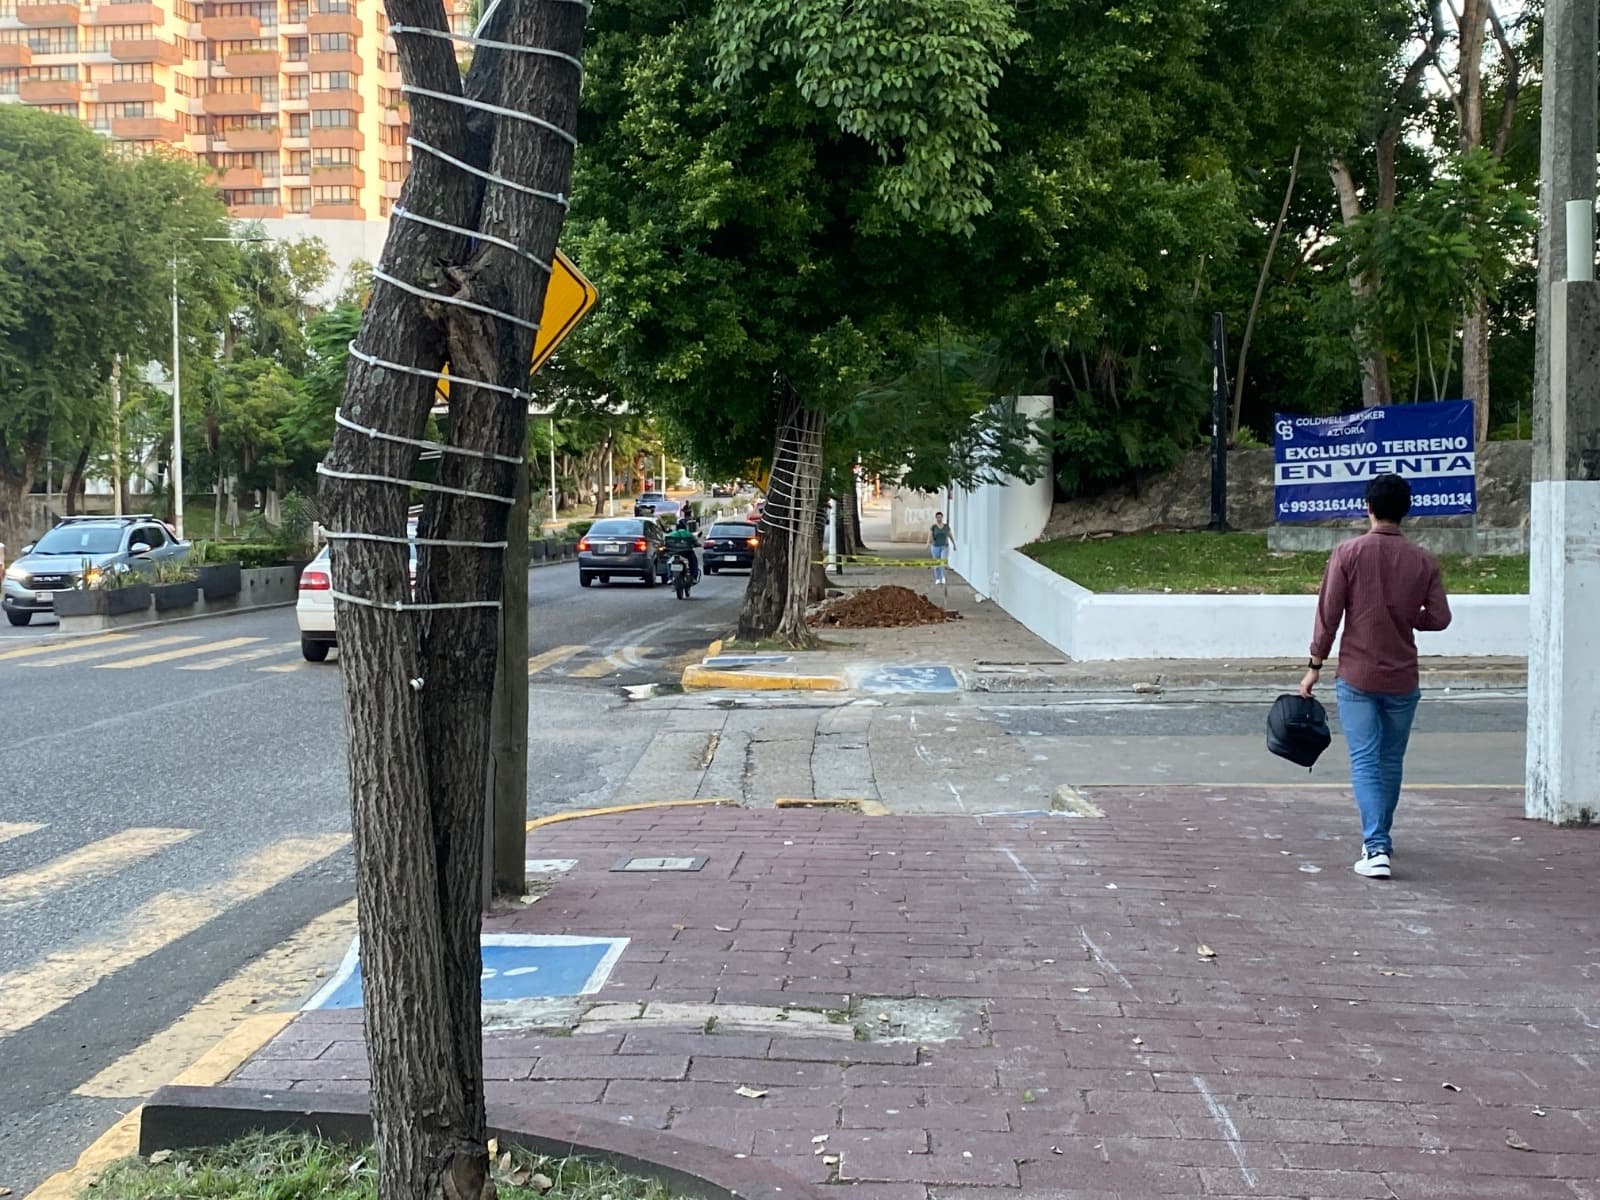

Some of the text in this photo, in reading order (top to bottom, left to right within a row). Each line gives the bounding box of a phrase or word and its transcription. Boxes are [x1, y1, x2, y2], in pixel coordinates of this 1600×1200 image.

[1296, 411, 1385, 427] COLDWELL BANKER
[1285, 436, 1468, 460] EXCLUSIVO TERRENO
[1281, 455, 1472, 480] EN VENTA
